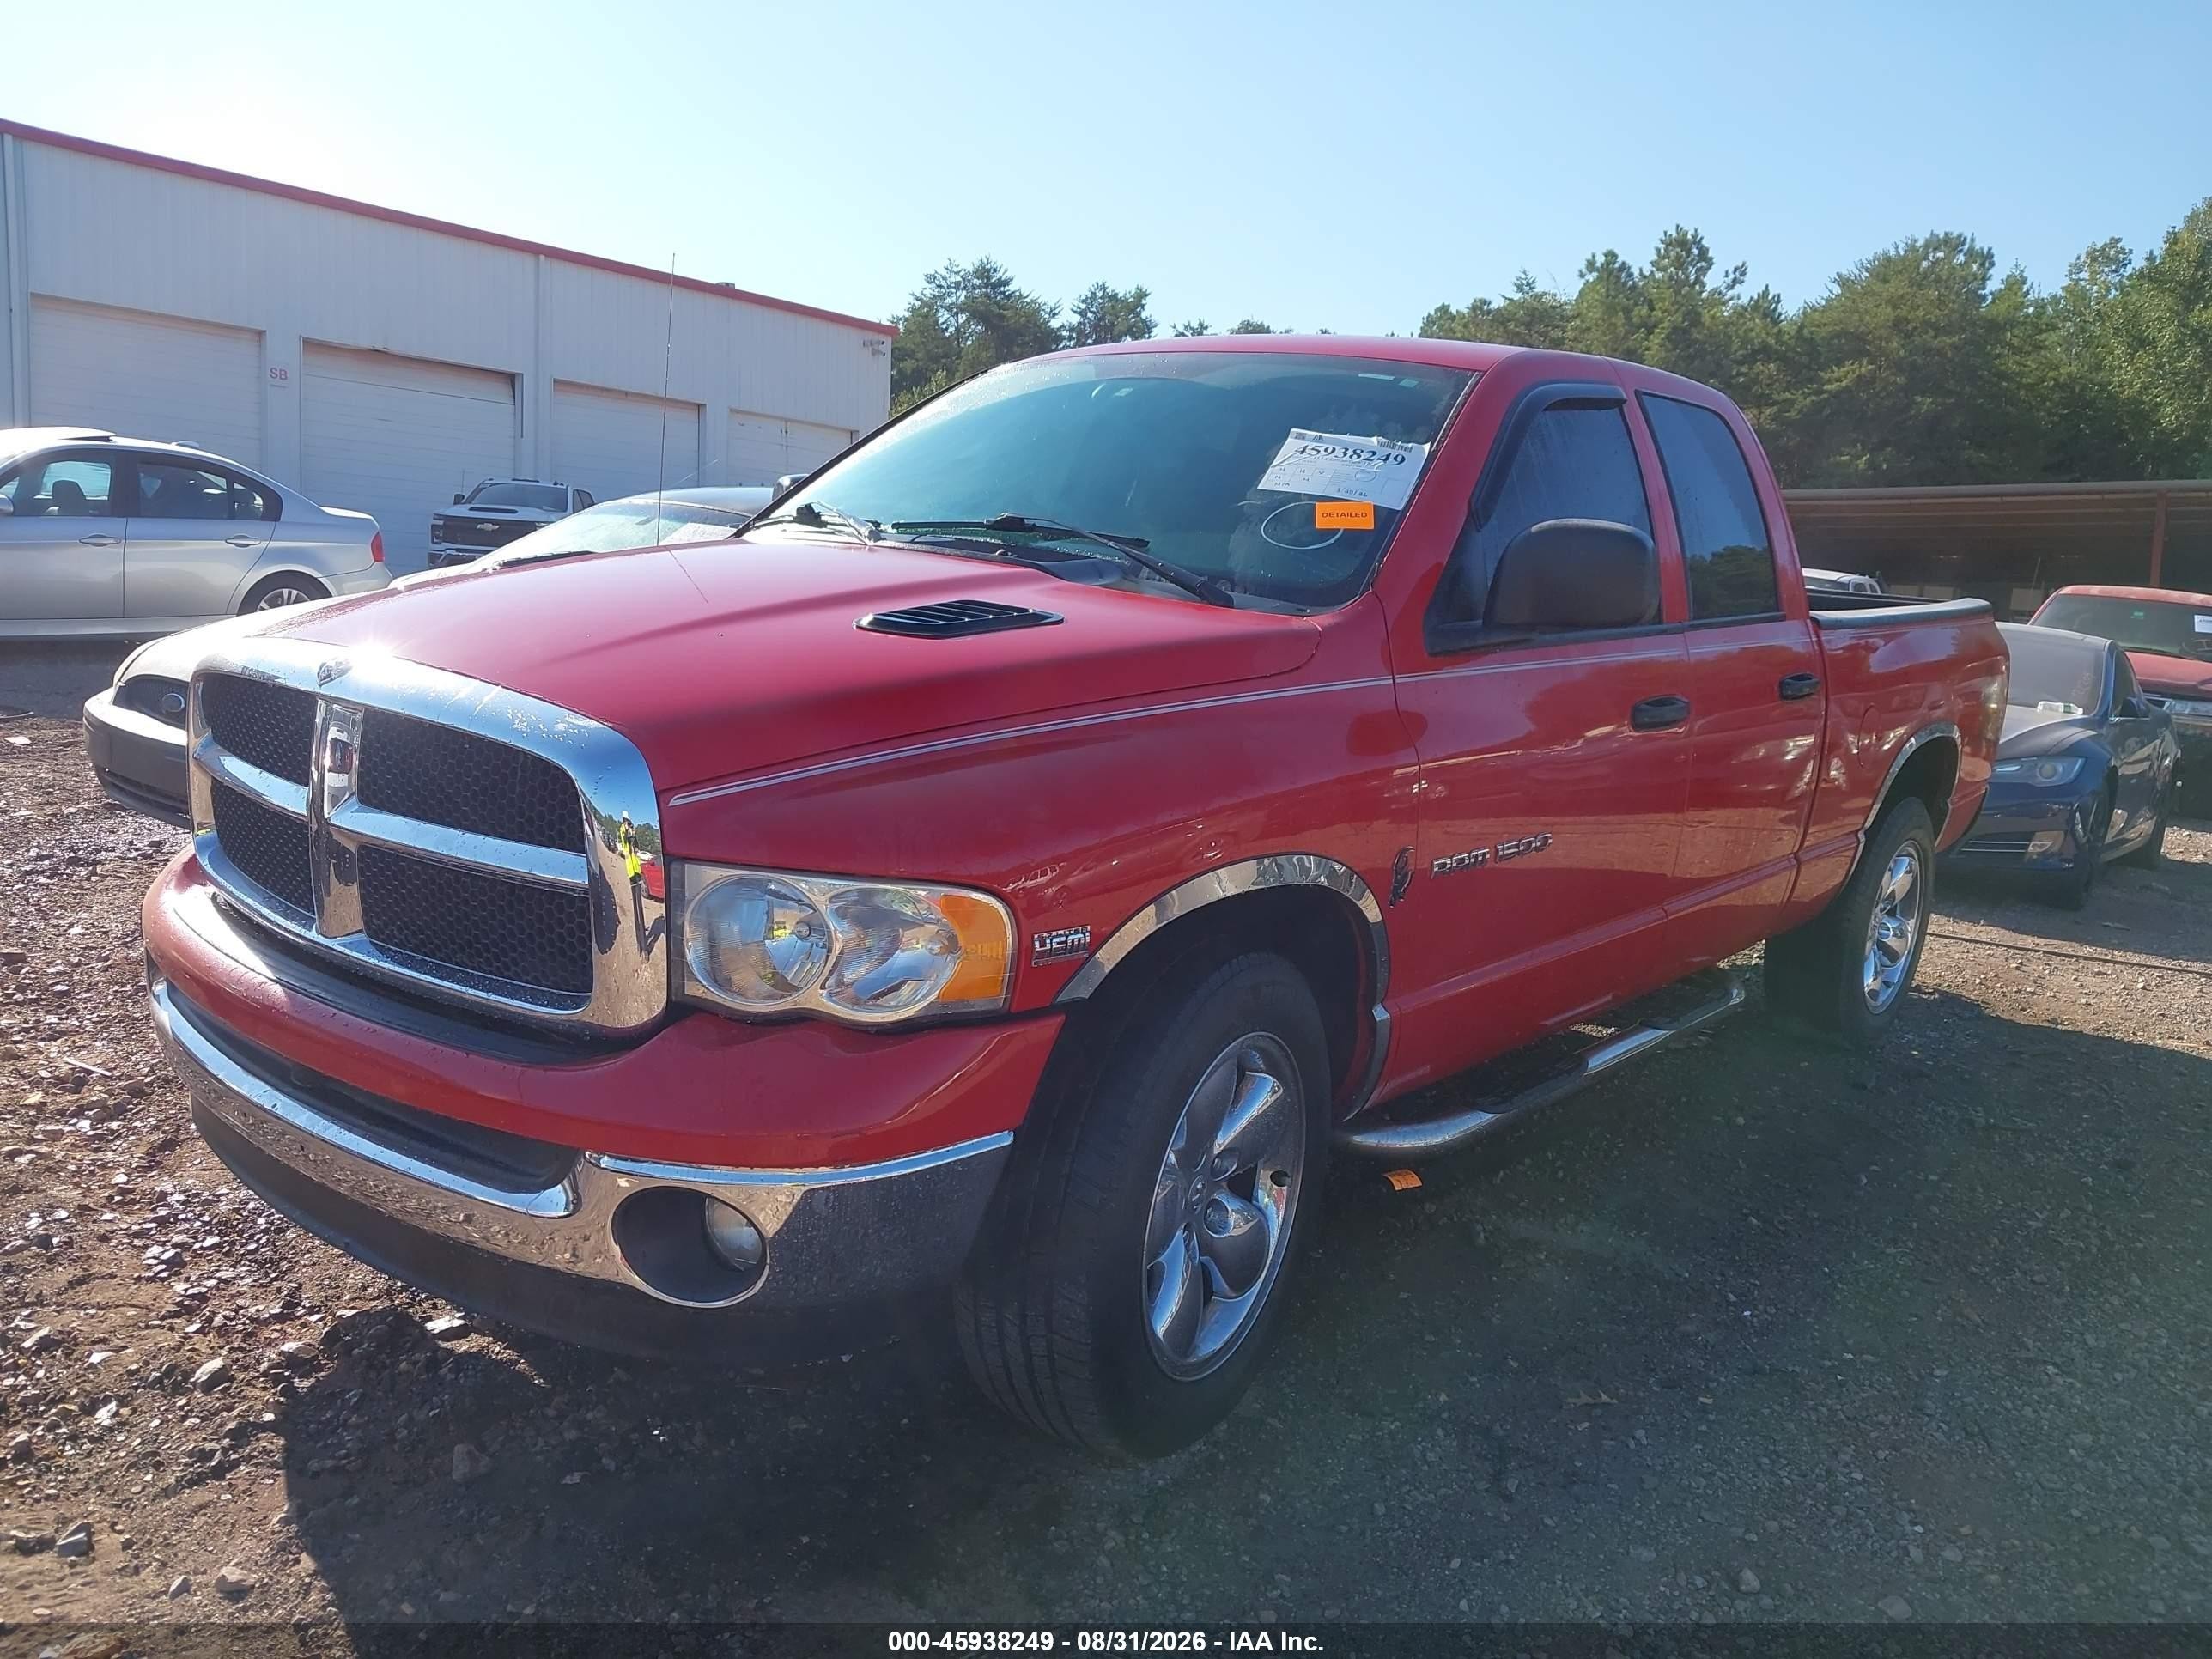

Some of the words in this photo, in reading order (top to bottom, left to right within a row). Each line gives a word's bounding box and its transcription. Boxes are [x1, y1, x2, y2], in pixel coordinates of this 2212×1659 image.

[270, 367, 288, 380] SB
[1294, 443, 1407, 466] 45938249
[1322, 511, 1368, 520] DETAILED
[1495, 831, 1553, 863] 1500
